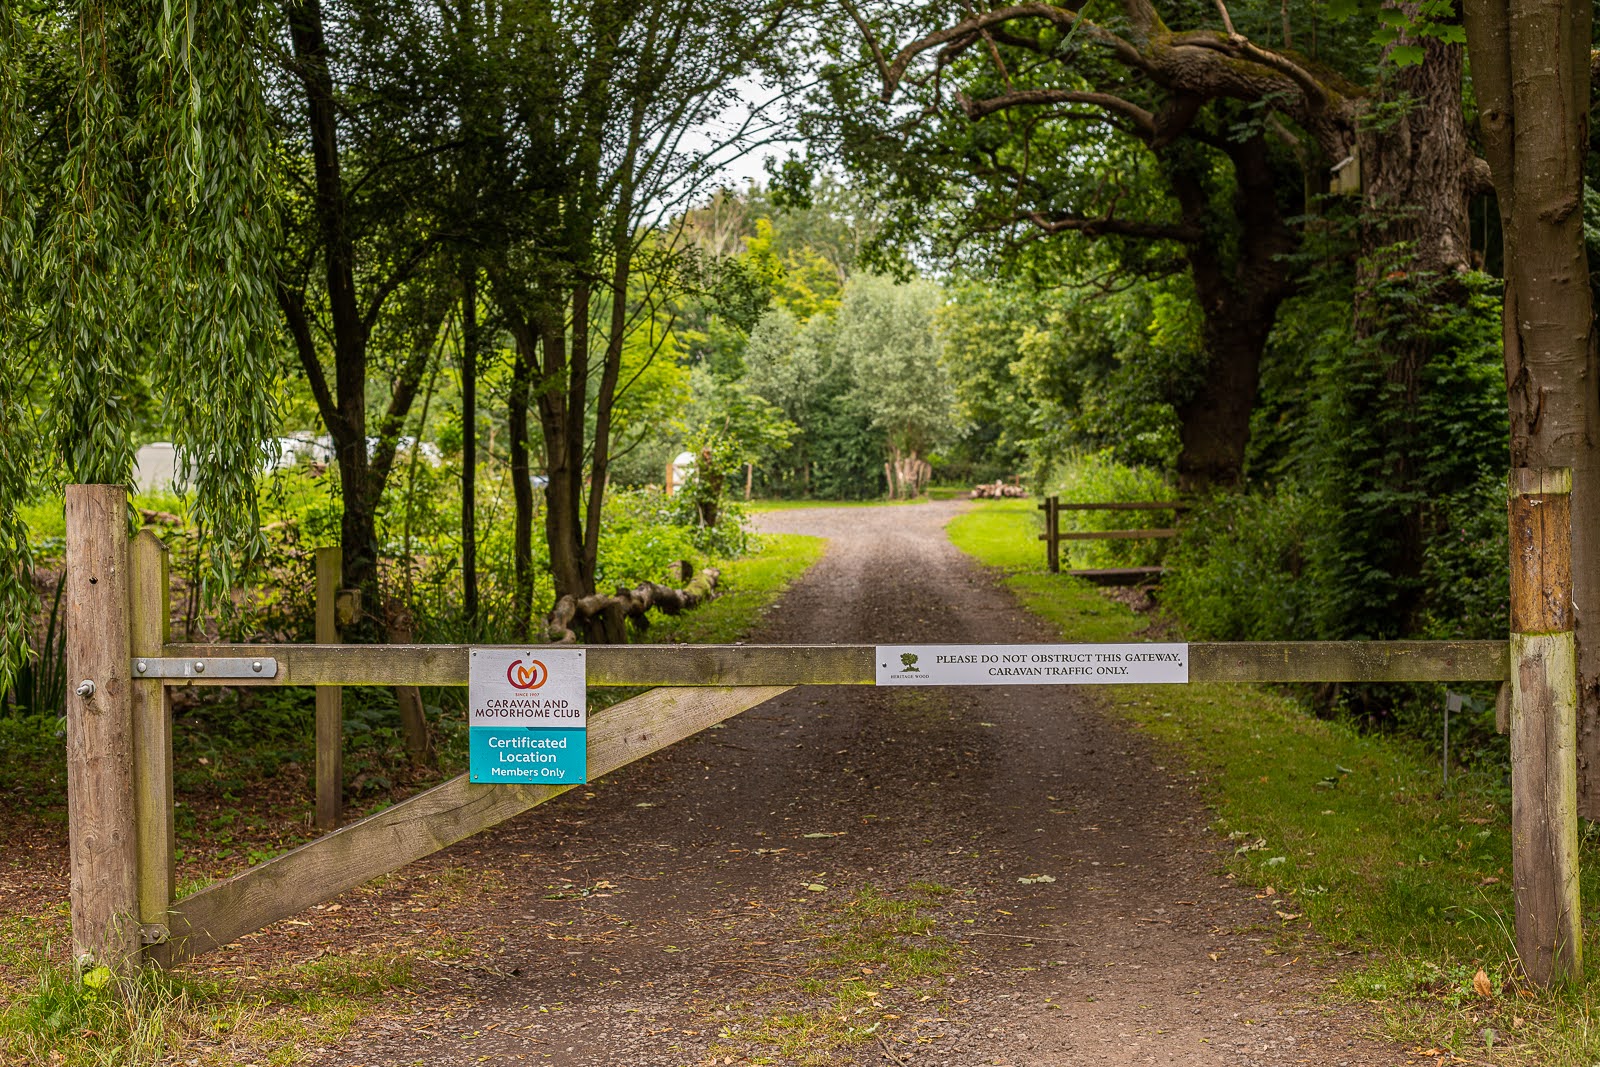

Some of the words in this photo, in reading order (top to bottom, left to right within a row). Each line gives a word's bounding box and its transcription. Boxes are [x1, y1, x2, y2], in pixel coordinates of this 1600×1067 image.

[936, 655, 978, 664] PLEASE
[980, 654, 999, 663] DO
[1002, 654, 1028, 663] NOT
[1031, 654, 1093, 663] OBSTRUCT
[1094, 653, 1122, 662] THIS
[988, 667, 1042, 676] CARAVAN
[1044, 666, 1093, 676] TRAFFIC
[1096, 666, 1129, 675] ONLY.
[486, 699, 540, 708] CARAVAN
[543, 700, 569, 709] AND
[475, 708, 550, 718] MOTORHOME
[553, 709, 581, 718] CLUB
[488, 736, 567, 749] Certificated
[499, 751, 557, 763] Location
[491, 767, 539, 777] Members
[540, 767, 565, 778] Only
